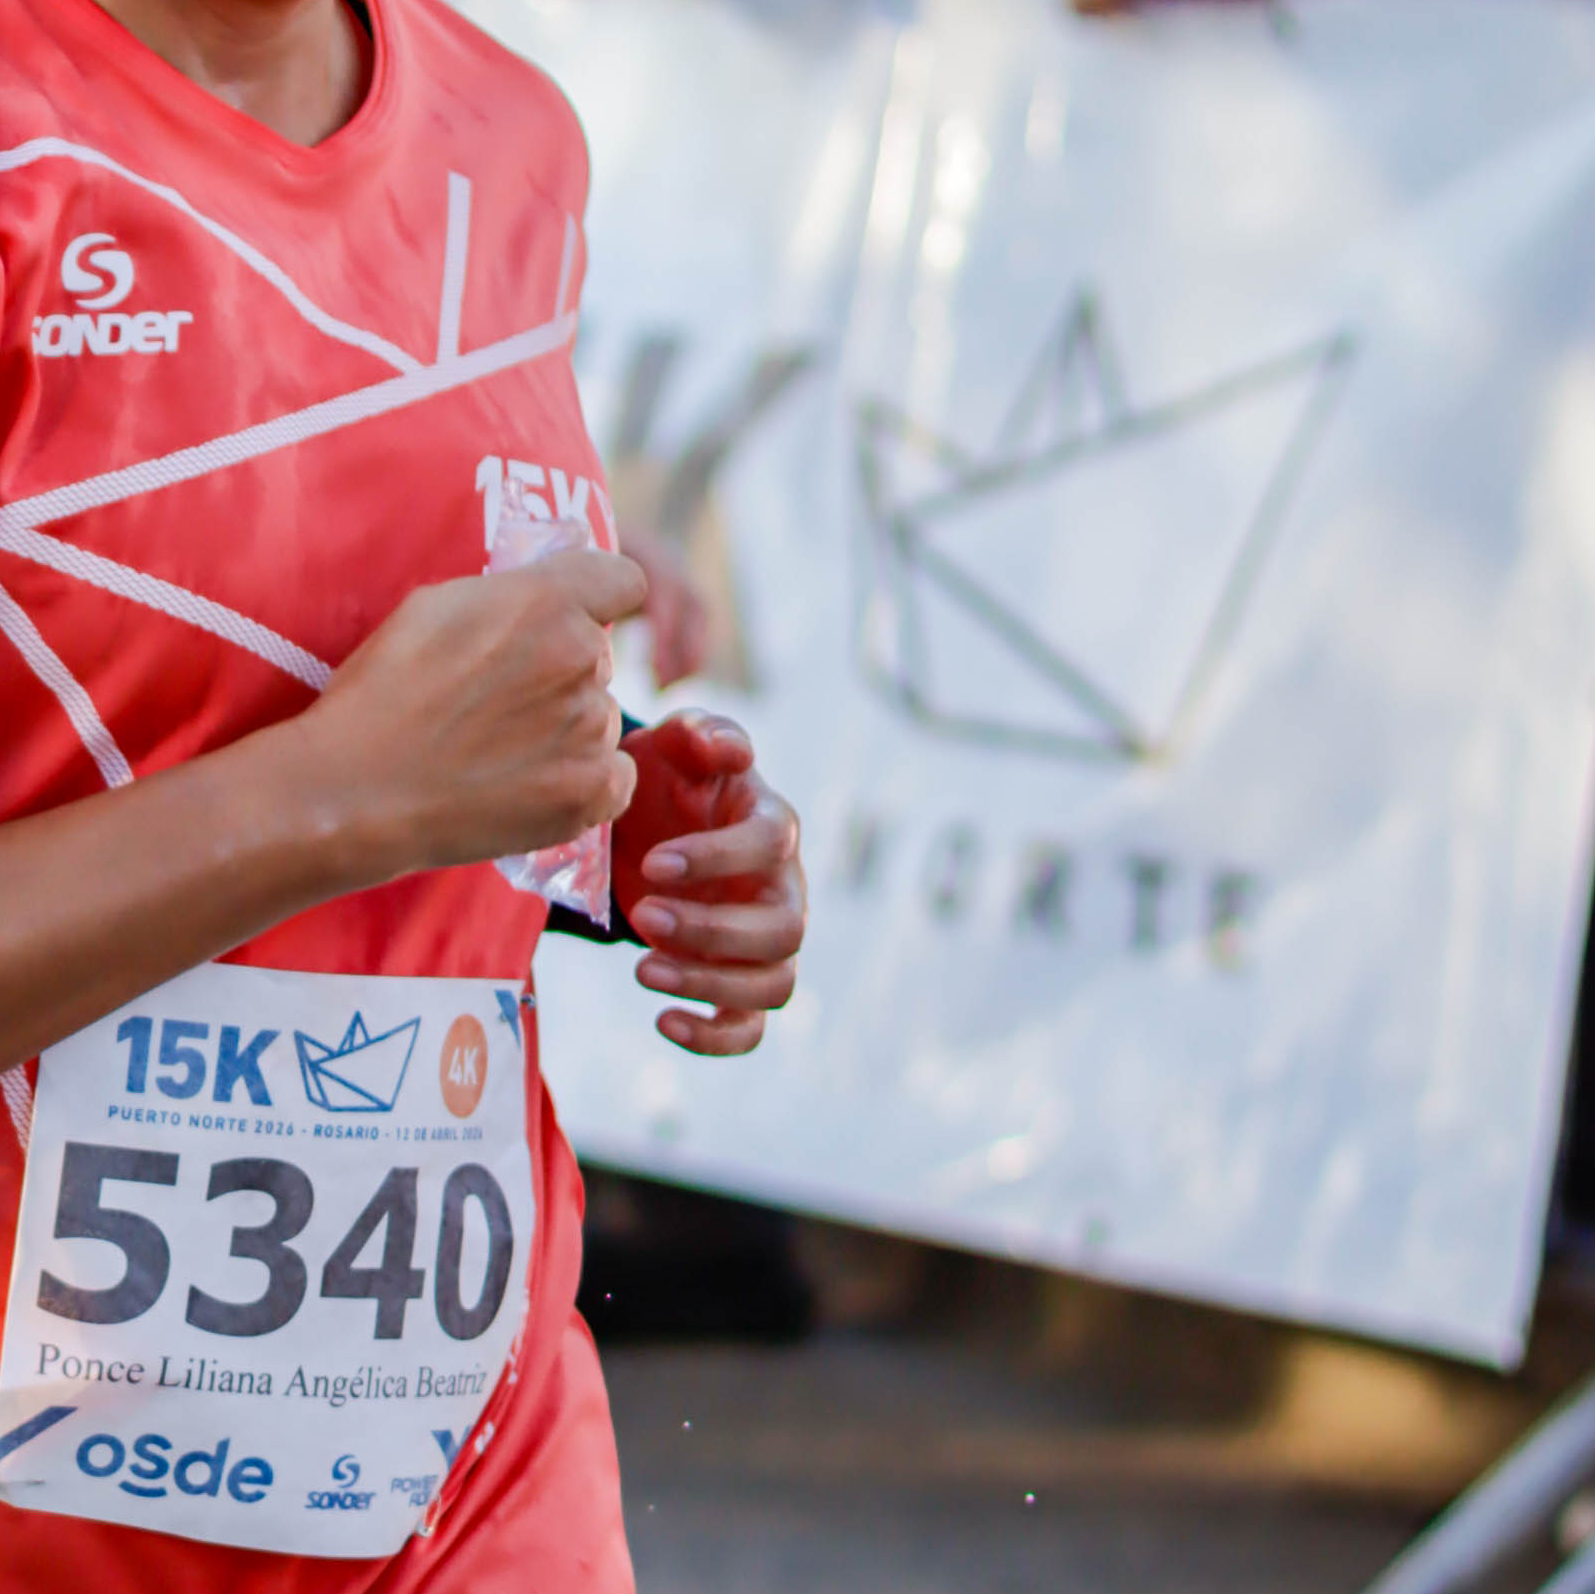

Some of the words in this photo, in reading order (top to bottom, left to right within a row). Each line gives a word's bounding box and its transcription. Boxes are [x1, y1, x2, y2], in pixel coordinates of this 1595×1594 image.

[117, 1015, 281, 1107] 15K
[449, 1045, 478, 1086] 4K
[107, 1105, 182, 1126] PUERTO
[188, 1113, 248, 1133] NORTE
[254, 1120, 294, 1136] 2026
[312, 1123, 380, 1140] ROSARIO
[430, 1126, 458, 1141] ABRIL
[36, 1140, 514, 1341] 5340
[37, 1343, 146, 1386] Ponce
[156, 1355, 273, 1396] Liliana
[283, 1363, 407, 1407] Angélica
[414, 1362, 487, 1400] Beatriz
[75, 1432, 274, 1503] osde
